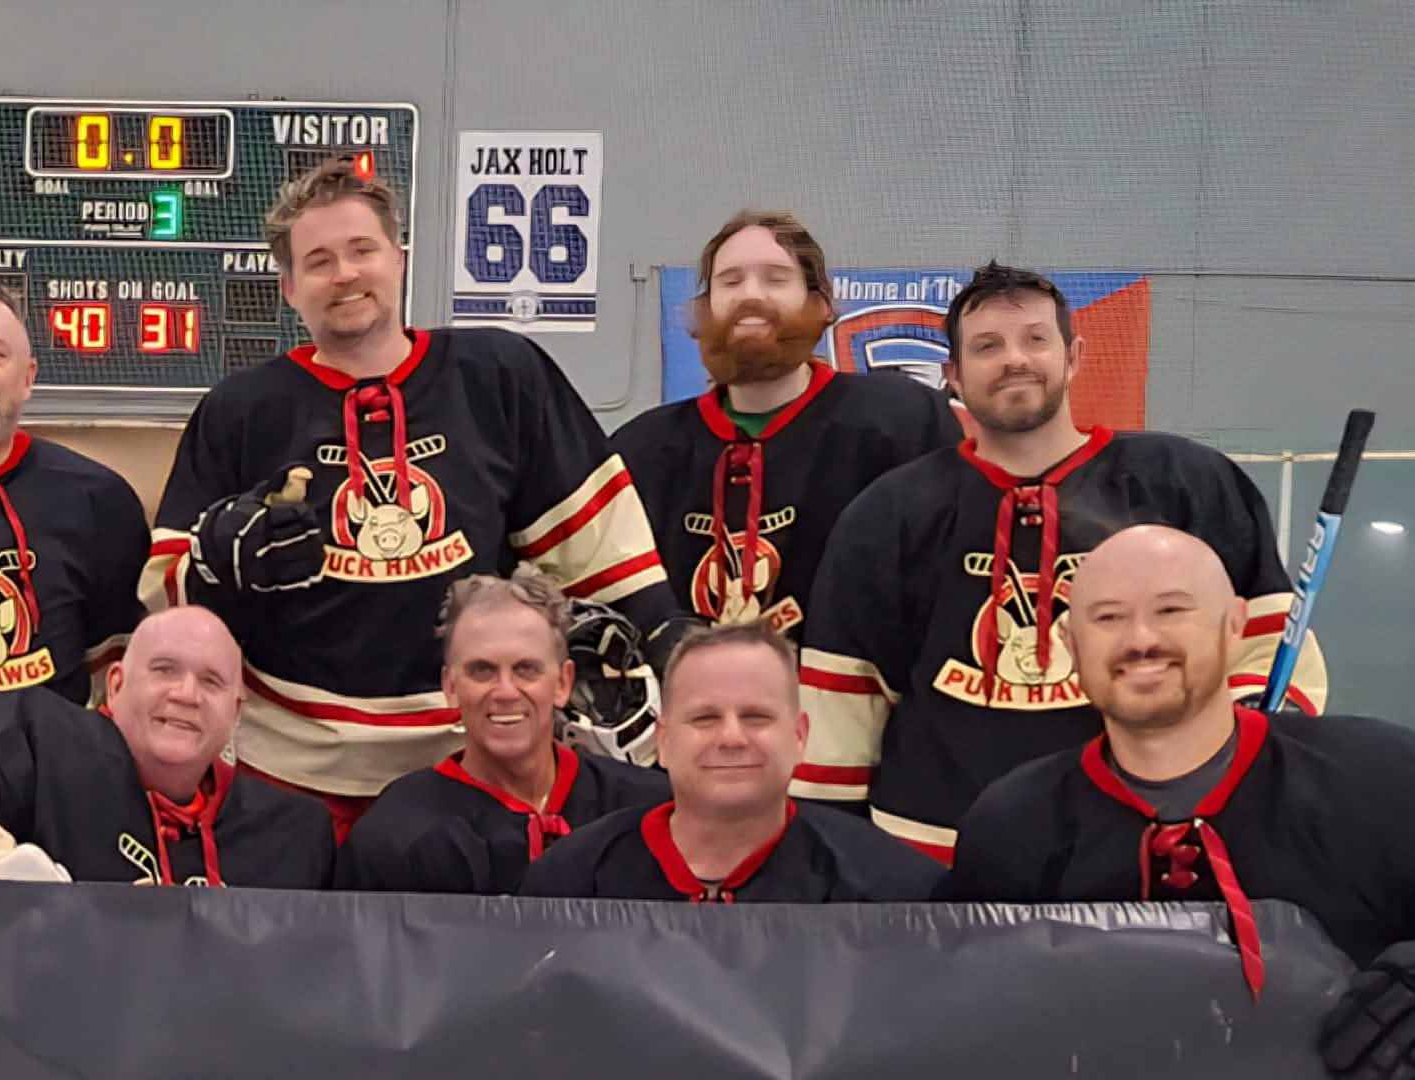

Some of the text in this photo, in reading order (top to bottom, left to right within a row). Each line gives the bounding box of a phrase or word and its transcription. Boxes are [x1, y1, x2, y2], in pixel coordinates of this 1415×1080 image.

[272, 115, 389, 145] VISITOR
[471, 148, 588, 176] JAX HOLT
[82, 201, 149, 220] PERIOD
[154, 194, 181, 237] 3
[464, 184, 589, 283] 66
[223, 251, 281, 273] PLAYE
[48, 280, 199, 300] SHOTS ON GOAL
[834, 276, 964, 300] Home of Th
[53, 306, 107, 349] 40
[142, 307, 195, 350] 31
[386, 541, 467, 578] HAWGS
